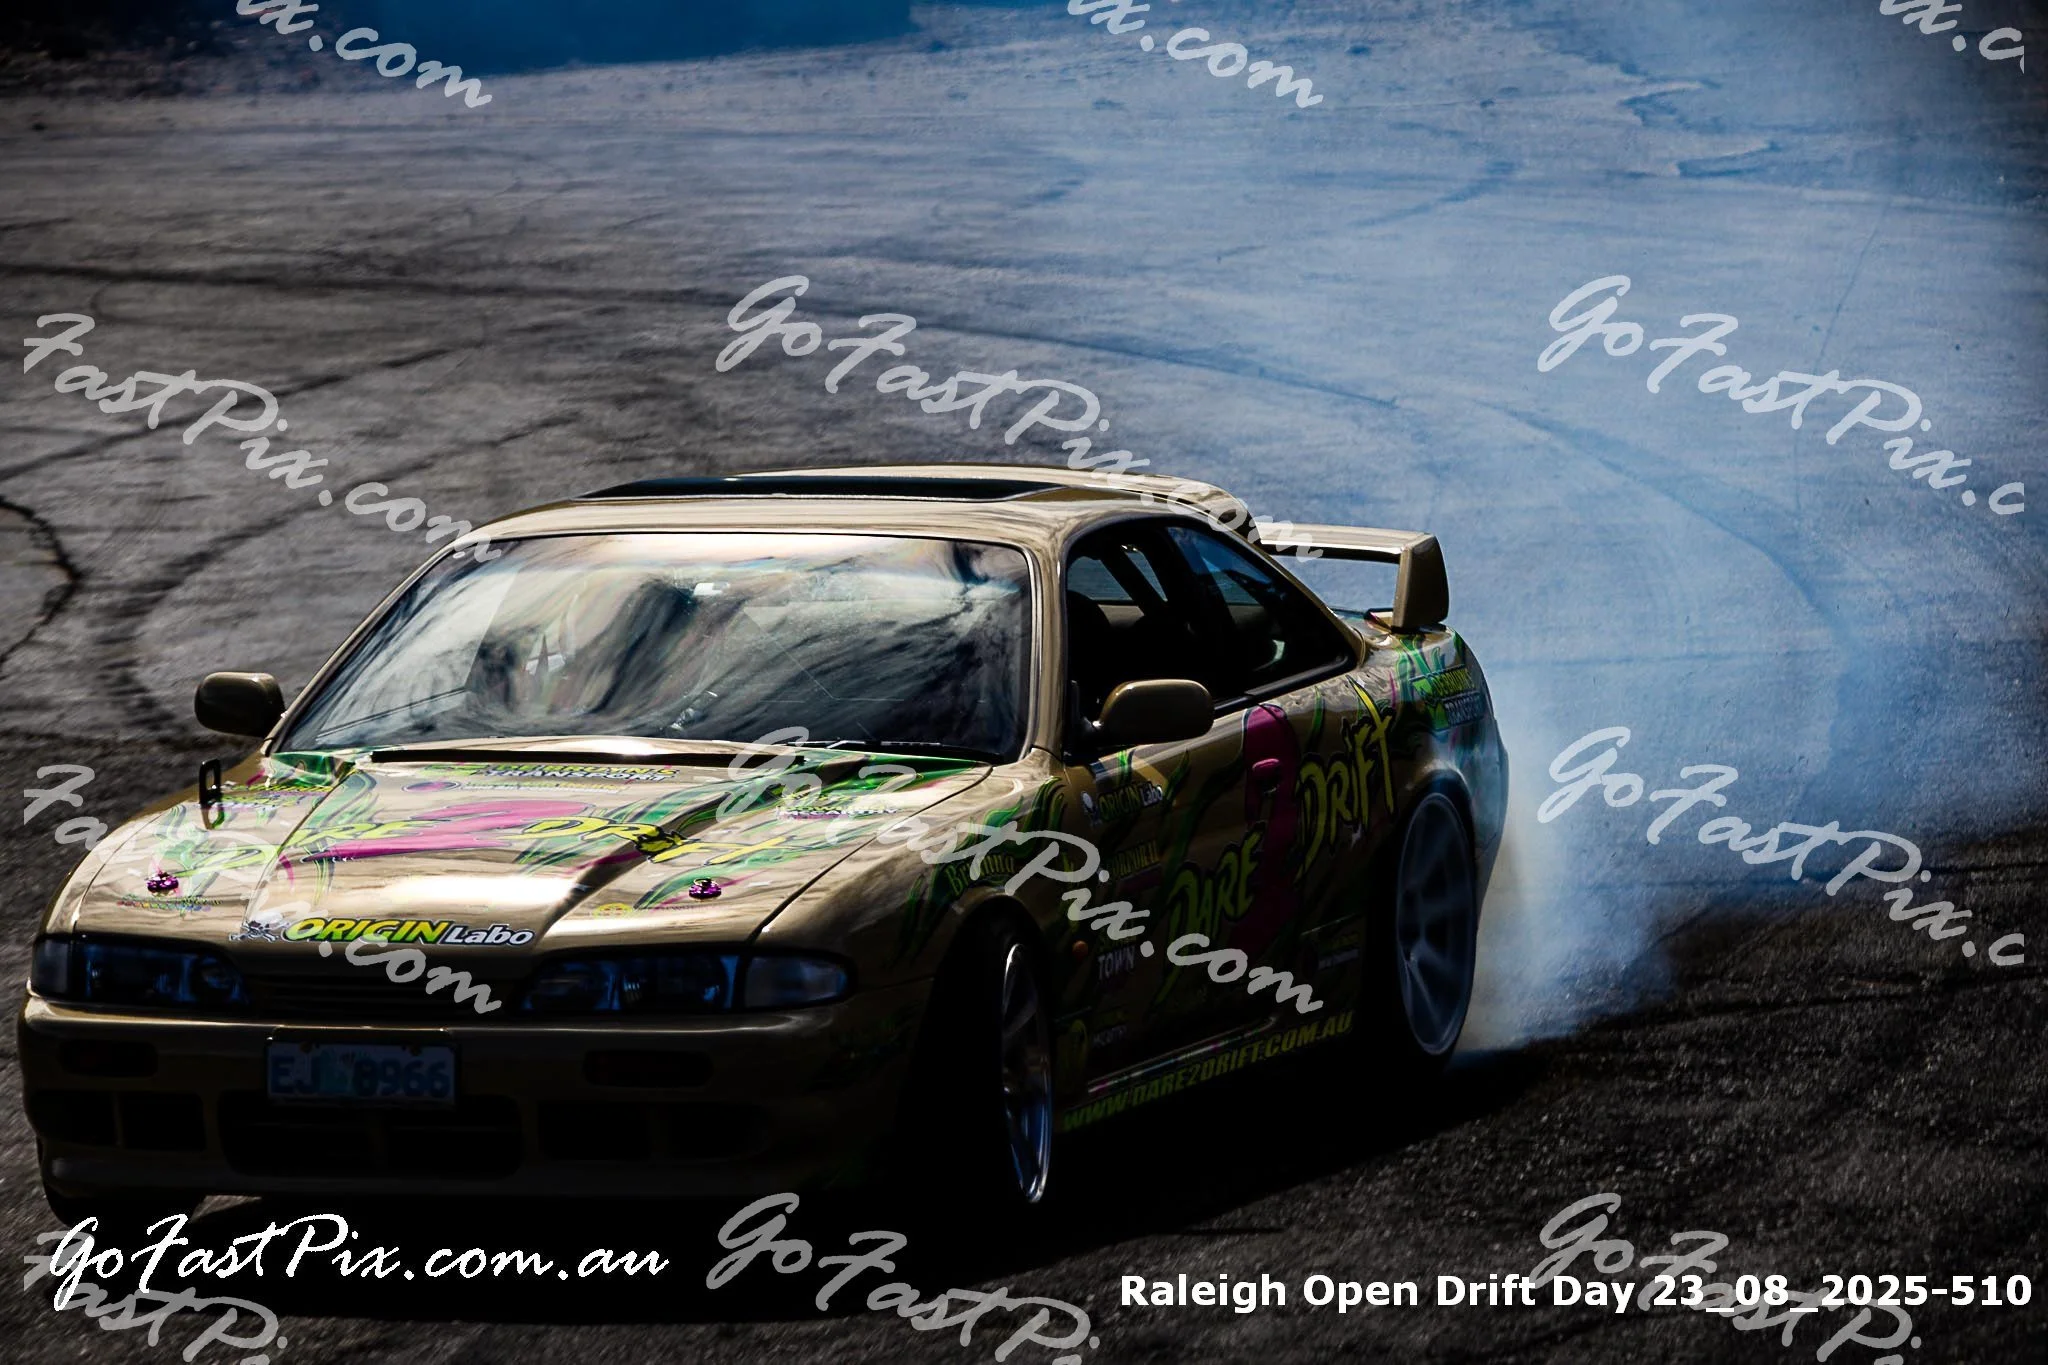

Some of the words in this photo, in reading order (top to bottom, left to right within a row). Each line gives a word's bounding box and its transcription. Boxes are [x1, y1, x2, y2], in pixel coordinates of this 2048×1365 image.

[1294, 678, 1397, 886] DRIFT
[281, 916, 452, 943] ORIGIN
[445, 923, 537, 946] Labo
[270, 1054, 323, 1094] EJ
[352, 1058, 450, 1098] 8966
